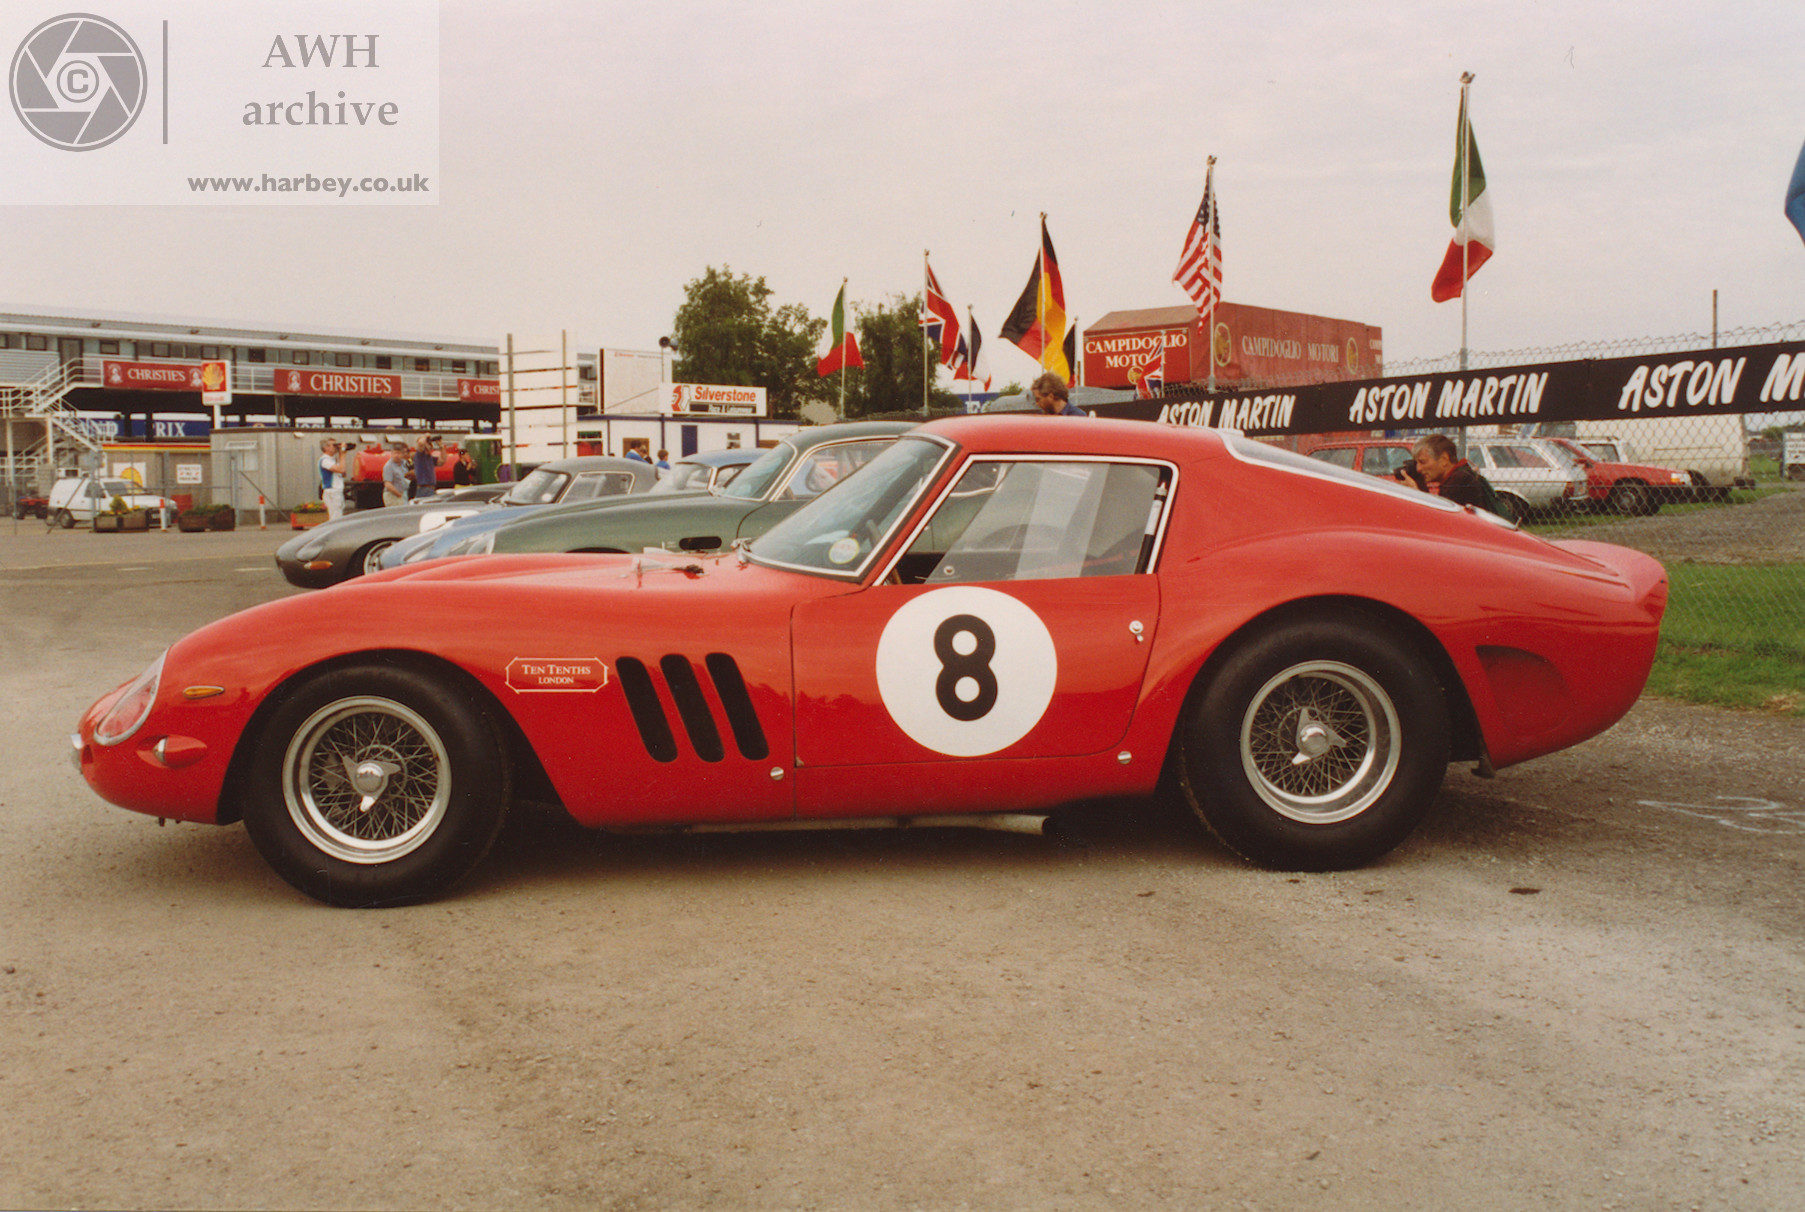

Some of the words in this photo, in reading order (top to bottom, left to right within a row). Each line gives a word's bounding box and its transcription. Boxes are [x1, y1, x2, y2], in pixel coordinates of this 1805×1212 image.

[1085, 334, 1188, 354] CAMPIDOGLIO
[1242, 335, 1302, 360] CAMPIDOGLIO
[1307, 343, 1339, 363] MOTORI
[694, 386, 757, 402] Silverstone
[1617, 356, 1747, 412] ASTON
[1759, 352, 1805, 403] M
[1157, 400, 1215, 428] ASTON
[1218, 394, 1297, 430] MARTIN
[1349, 381, 1432, 424] ASTON
[1435, 372, 1549, 418] MARTIN
[152, 421, 186, 437] RIX
[538, 676, 574, 684] LONDON
[934, 614, 998, 722] 8
